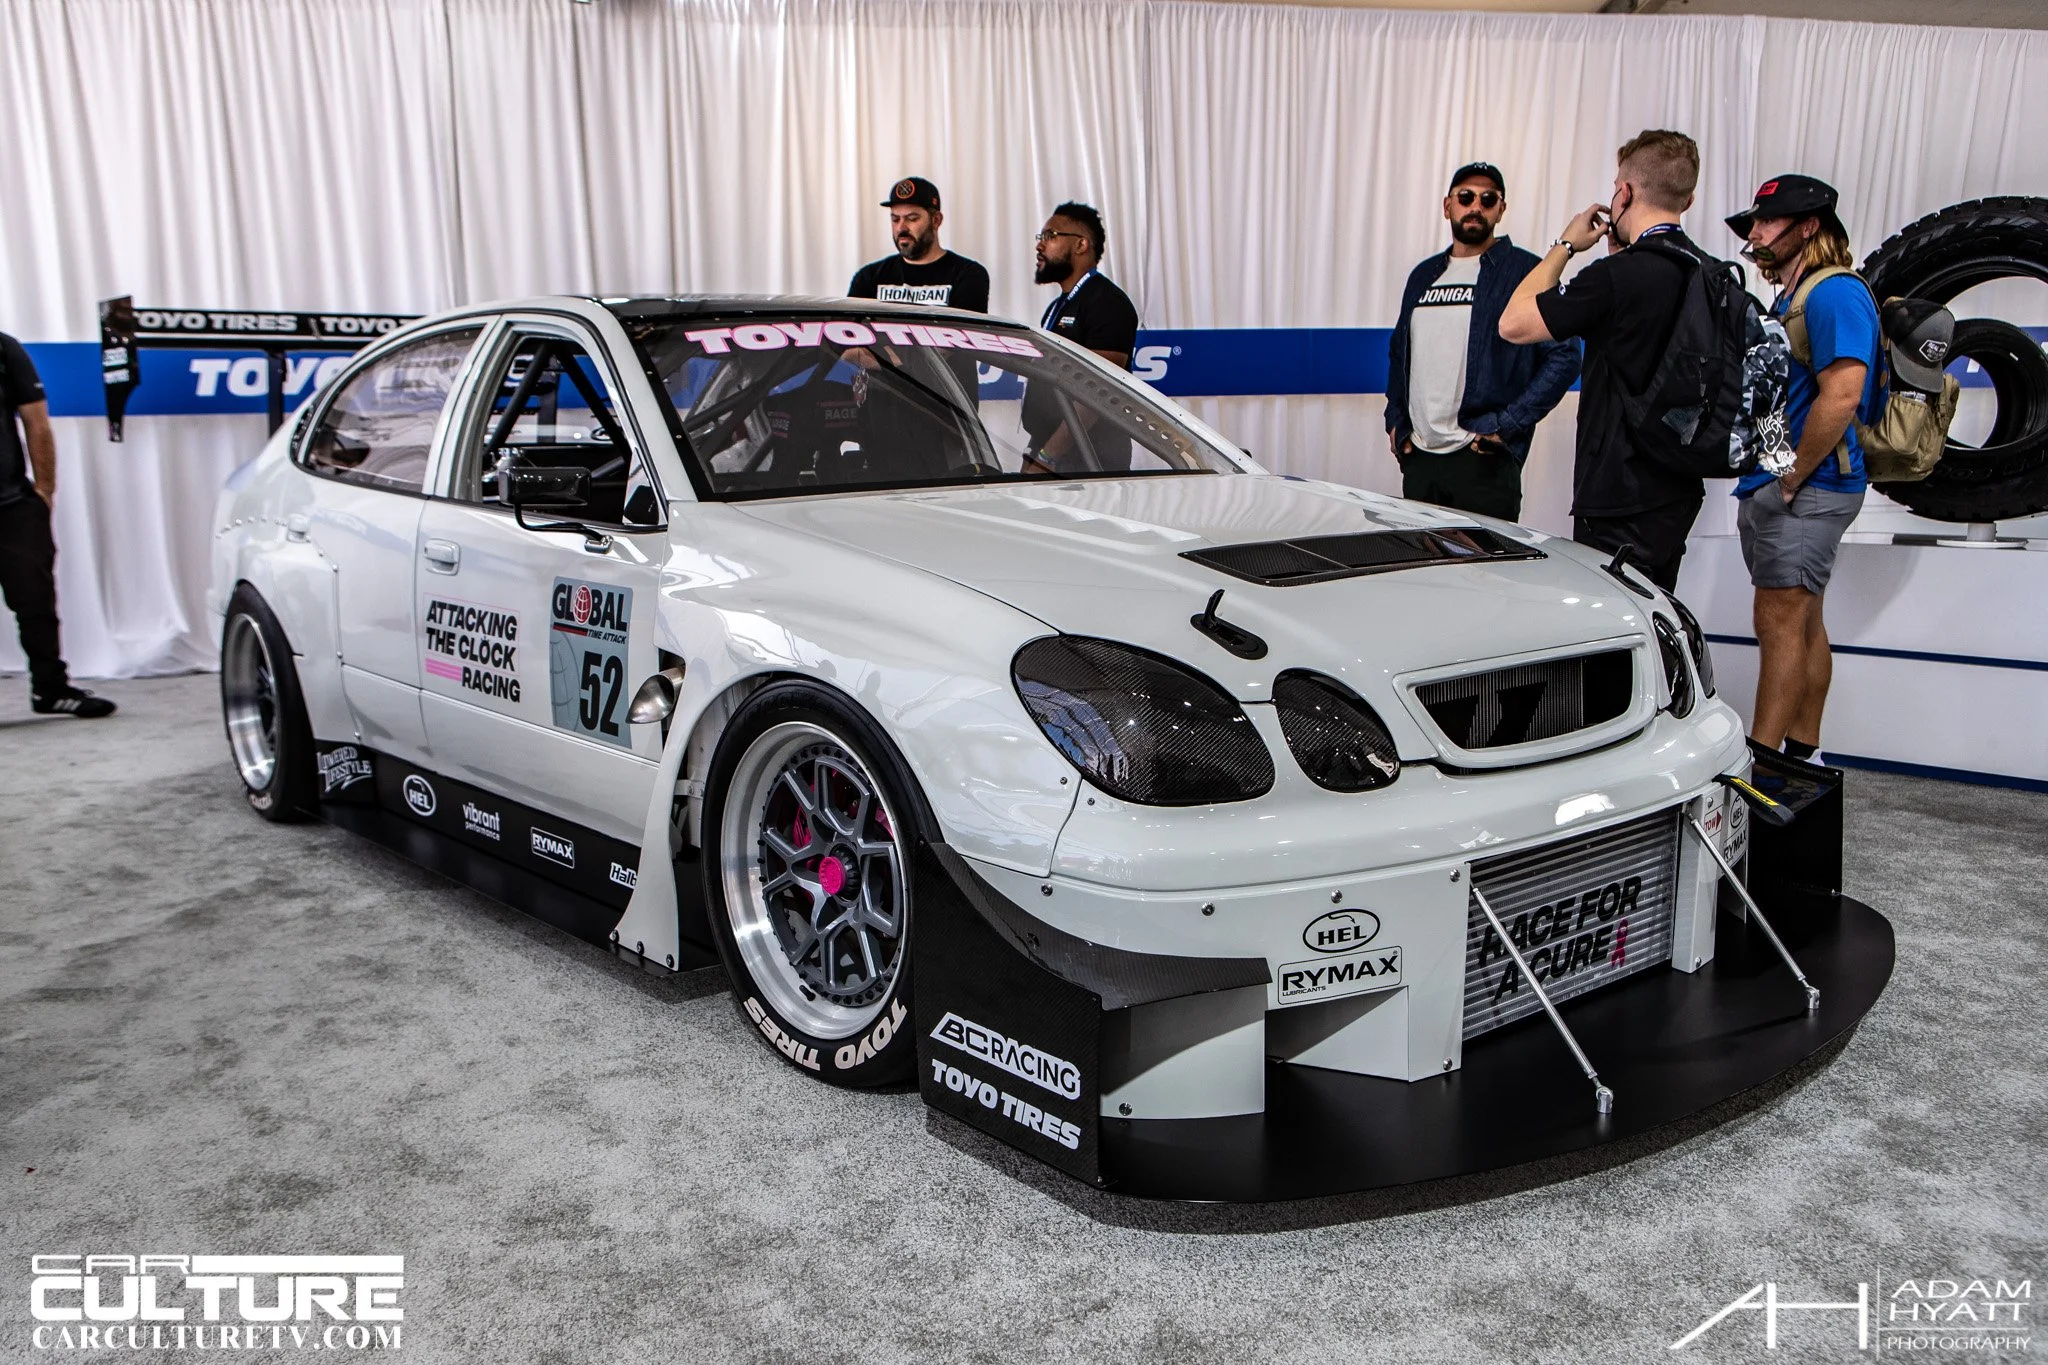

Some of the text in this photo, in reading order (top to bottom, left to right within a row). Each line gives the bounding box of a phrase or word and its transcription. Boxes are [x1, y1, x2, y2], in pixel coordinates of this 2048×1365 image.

[133, 311, 298, 332] OYO TIRES
[320, 316, 398, 334] TOYO
[685, 321, 1044, 358] TOYO TIRES
[426, 600, 518, 641] ATTACKING
[552, 583, 628, 632] GLOBAL
[426, 626, 517, 672] THE CLOCK
[587, 628, 627, 645] TIME ATTACK
[461, 666, 521, 703] RACING
[579, 650, 624, 737] 52
[409, 789, 431, 809] HEL
[462, 802, 500, 832] vibrant
[1704, 816, 1717, 832] TOW
[532, 833, 574, 860] RYMAX
[610, 863, 637, 888] Halt
[1318, 925, 1368, 946] HEL
[1479, 876, 1641, 968] RACE FOR
[1491, 925, 1613, 1006] A CURE
[1282, 986, 1327, 997] LUBRICANTS
[743, 997, 908, 1071] TOYO TIRES
[931, 1058, 1081, 1150] TOYO TIRES
